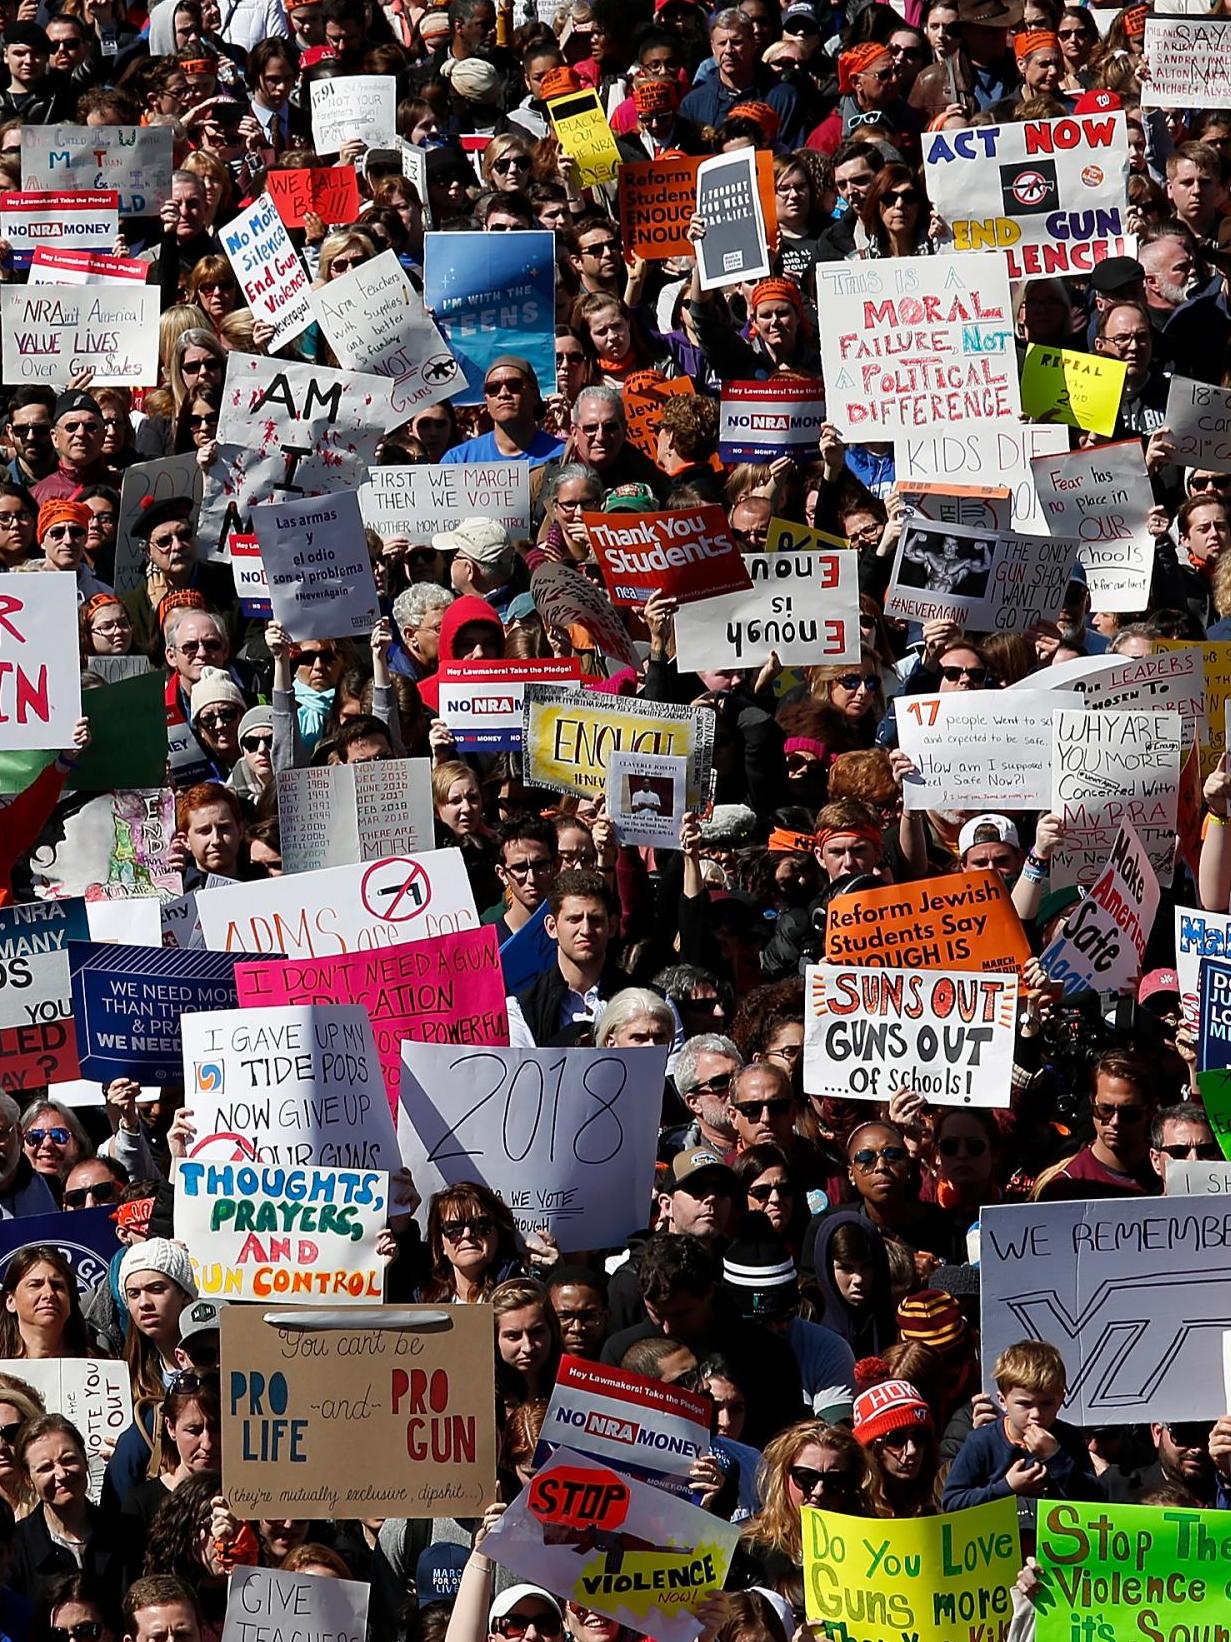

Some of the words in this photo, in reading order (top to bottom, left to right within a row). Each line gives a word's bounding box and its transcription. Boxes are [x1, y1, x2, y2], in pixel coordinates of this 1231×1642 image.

[927, 126, 1000, 165] ACT
[1025, 117, 1116, 154] NOW
[272, 175, 302, 194] WE
[306, 172, 352, 191] CALL
[8, 226, 28, 236] NO
[30, 225, 61, 235] NRA
[64, 224, 111, 234] MONEY
[952, 216, 1023, 251] END
[1045, 208, 1122, 240] GUN
[245, 267, 276, 303] End
[275, 254, 297, 276] Gun
[264, 270, 306, 313] Violence
[440, 301, 539, 339] TEENS
[863, 290, 1004, 330] MORAL
[14, 332, 61, 352] VALUE
[862, 356, 1008, 395] POLITICAL
[847, 386, 1013, 426] DIFFERENCE
[908, 438, 981, 476] KIDS
[370, 471, 418, 489] FIRST
[427, 470, 455, 488] WE
[464, 469, 520, 486] MARCH
[276, 513, 294, 528] Las
[298, 509, 337, 525] armas
[375, 492, 416, 509] THEN
[431, 490, 459, 508] WE
[468, 490, 513, 507] VOTE
[590, 521, 660, 546] Thank
[656, 516, 706, 539] You
[1078, 515, 1131, 540] OUR
[605, 535, 732, 573] Students
[1001, 540, 1030, 561] THE
[1038, 543, 1073, 561] ONLY
[996, 561, 1024, 581] GUN
[1035, 565, 1071, 585] SHOW
[616, 587, 637, 599] nea
[907, 700, 940, 726] 17
[945, 715, 987, 734] people
[1059, 713, 1117, 743] WHY
[1120, 716, 1169, 744] ARE
[1059, 742, 1101, 772] YOU
[1106, 753, 1173, 770] MORE
[358, 806, 376, 815] FEB
[382, 802, 407, 811] 2018
[830, 903, 912, 929] Reform
[921, 877, 1000, 911] Jewish
[26, 998, 73, 1024] YOU
[827, 972, 923, 1018] SUNS
[932, 978, 1004, 1022] OUT
[205, 1029, 224, 1052] I
[230, 1025, 301, 1053] GAVE
[316, 1024, 346, 1052] UP
[344, 1024, 366, 1053] MY
[827, 1021, 908, 1062] GUNS
[917, 1027, 993, 1065] OUT
[428, 1053, 627, 1163] 2018
[179, 1163, 385, 1208] THOUGHTS,
[211, 1200, 363, 1241] PRAYERS,
[238, 1232, 318, 1264] AND
[990, 1224, 1051, 1261] WE
[253, 1269, 382, 1296] CONTROL
[231, 1370, 288, 1416] PRO
[391, 1368, 447, 1414] PRO
[242, 1419, 308, 1462] LIFE
[407, 1415, 476, 1463] GUN
[532, 1478, 626, 1520] STOP
[811, 1512, 845, 1562] Do
[863, 1537, 920, 1578] You
[942, 1524, 1013, 1576] Love
[1043, 1505, 1151, 1571] Stop
[582, 1553, 716, 1594] VIOLENCE
[1051, 1567, 1205, 1607] Violence
[242, 1576, 311, 1614] GIVE
[658, 1589, 698, 1603] NOW!
